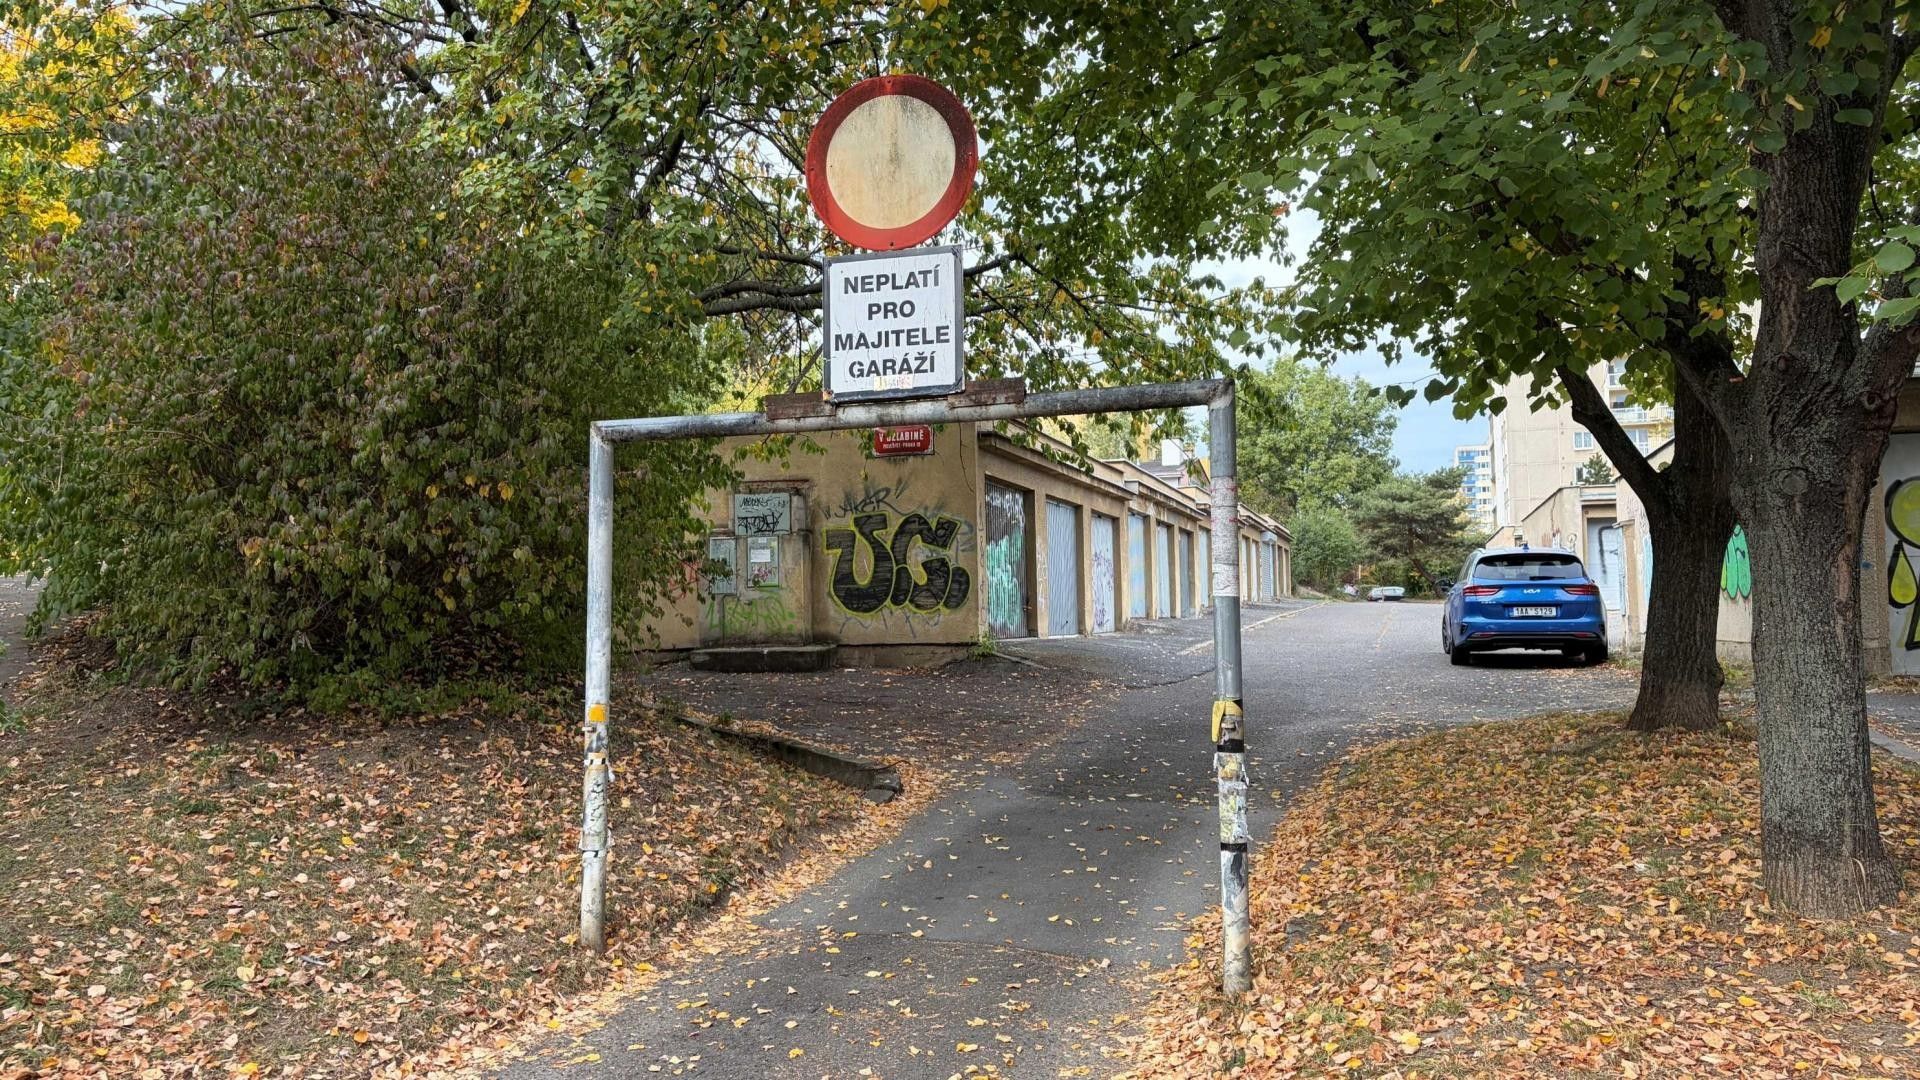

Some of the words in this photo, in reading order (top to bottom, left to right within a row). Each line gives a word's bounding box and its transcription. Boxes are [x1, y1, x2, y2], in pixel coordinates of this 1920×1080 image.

[843, 264, 940, 294] NEPLATÍ
[867, 300, 916, 320] PRO
[834, 325, 950, 351] MAJITELE
[848, 351, 936, 379] GARÁŽÍ
